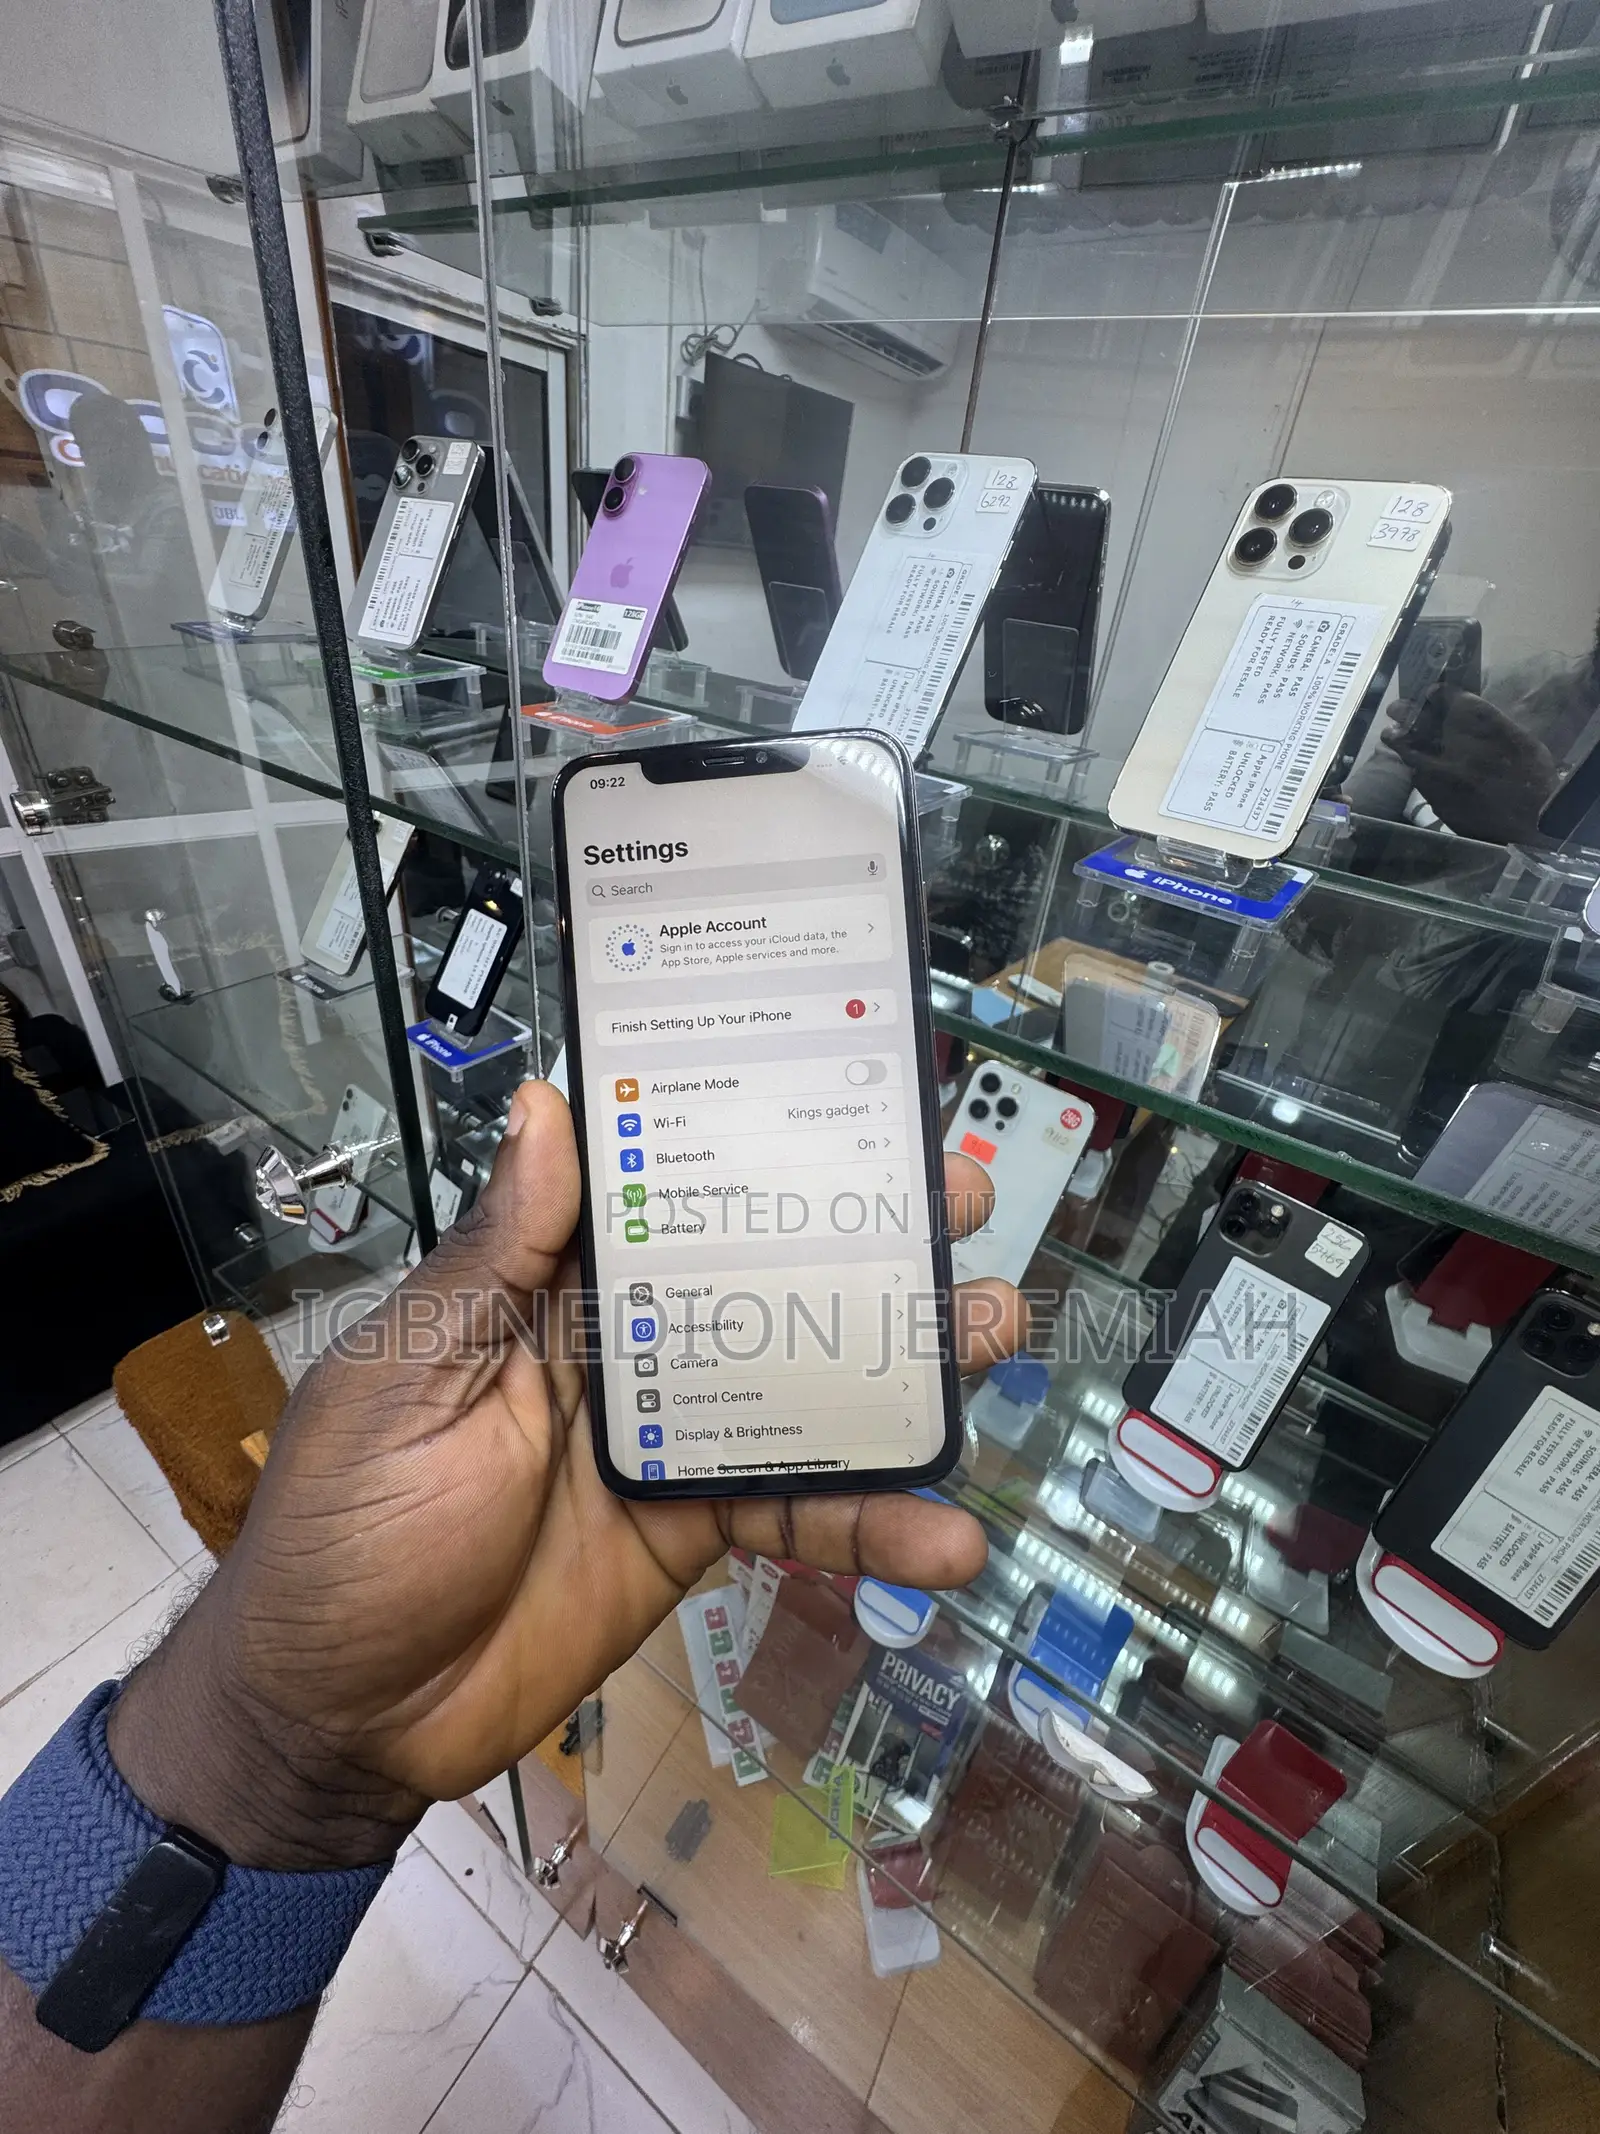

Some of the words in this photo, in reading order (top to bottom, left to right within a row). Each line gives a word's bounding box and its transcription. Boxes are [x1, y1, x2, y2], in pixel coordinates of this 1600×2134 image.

[992, 470, 1017, 489] 128
[981, 492, 1011, 508] 6292
[1391, 496, 1429, 517] 128
[1374, 523, 1420, 542] 3978
[1258, 615, 1276, 643] READY
[1271, 616, 1286, 643] FULLY
[1328, 622, 1348, 657] GRADE:
[1248, 646, 1262, 664] FOR
[1253, 645, 1273, 677] TESTED
[1269, 631, 1296, 678] NETWORK:
[1285, 633, 1308, 673] SOUNDS:
[1300, 635, 1322, 672] CAMERA:
[1232, 666, 1252, 698] RESALE
[1257, 683, 1272, 704] PASS
[1273, 677, 1288, 699] PASS
[1288, 676, 1303, 697] PASS
[1307, 675, 1324, 699] 100%
[1287, 702, 1312, 741] WORKING
[1216, 750, 1237, 788] BATTERY:
[1251, 754, 1268, 778] Apple
[1274, 744, 1293, 771] PHONE
[589, 776, 626, 790] 09:22
[1225, 752, 1252, 799] UNLOCKED
[1203, 791, 1218, 812] PASS
[1237, 781, 1257, 808] iPhone
[583, 838, 689, 866] Settings
[611, 882, 653, 897] Search
[1152, 876, 1233, 905] iPhone
[659, 922, 702, 939] Apple
[706, 916, 767, 933] Account
[660, 943, 682, 955] Sign
[684, 941, 693, 951] in
[695, 940, 706, 950] to
[708, 939, 743, 949] access
[744, 938, 766, 948] your
[769, 933, 801, 944] iCloud
[803, 931, 828, 942] data,
[831, 929, 848, 939] the
[661, 958, 681, 969] App
[683, 955, 713, 966] Store,
[716, 952, 744, 963] Apple
[746, 950, 787, 961] services
[789, 946, 808, 957] and
[811, 945, 840, 955] more.
[612, 1021, 647, 1034] Finish
[650, 1018, 694, 1032] Setting
[697, 1016, 715, 1028] Up
[718, 1013, 746, 1025] Your
[749, 1010, 792, 1023] iPhone
[651, 1079, 701, 1095] Airplane
[704, 1077, 740, 1090] Mode
[653, 1115, 687, 1129] Wi-Fi
[788, 1105, 823, 1120] Kings
[826, 1103, 870, 1119] gadget
[857, 1138, 876, 1150] On
[655, 1150, 715, 1165] Bluetooth
[658, 1185, 701, 1200] Mobile
[702, 1182, 749, 1197] Service
[661, 1221, 706, 1236] Battery
[665, 1285, 713, 1300] General
[668, 1319, 744, 1336] Accessibility
[669, 1356, 718, 1370] Camera
[673, 1392, 717, 1406] Control
[721, 1390, 763, 1402] Centre
[675, 1427, 720, 1442] Display
[723, 1427, 734, 1439] &
[736, 1424, 803, 1439] Brightness
[1546, 1411, 1565, 1437] READY
[1556, 1417, 1576, 1440] FULLY
[1533, 1435, 1547, 1451] FOR
[1537, 1441, 1560, 1467] TESTED
[1514, 1450, 1537, 1477] RESALE
[1553, 1437, 1585, 1475] NETWORK:
[1570, 1444, 1597, 1476] SOUNDS:
[677, 1465, 715, 1477] Home
[1539, 1475, 1556, 1494] PASS
[1555, 1477, 1573, 1496] PASS
[1571, 1483, 1588, 1502] PASS
[1499, 1531, 1529, 1567] UNLOCKED
[880, 1651, 961, 1711] PRIVACY
